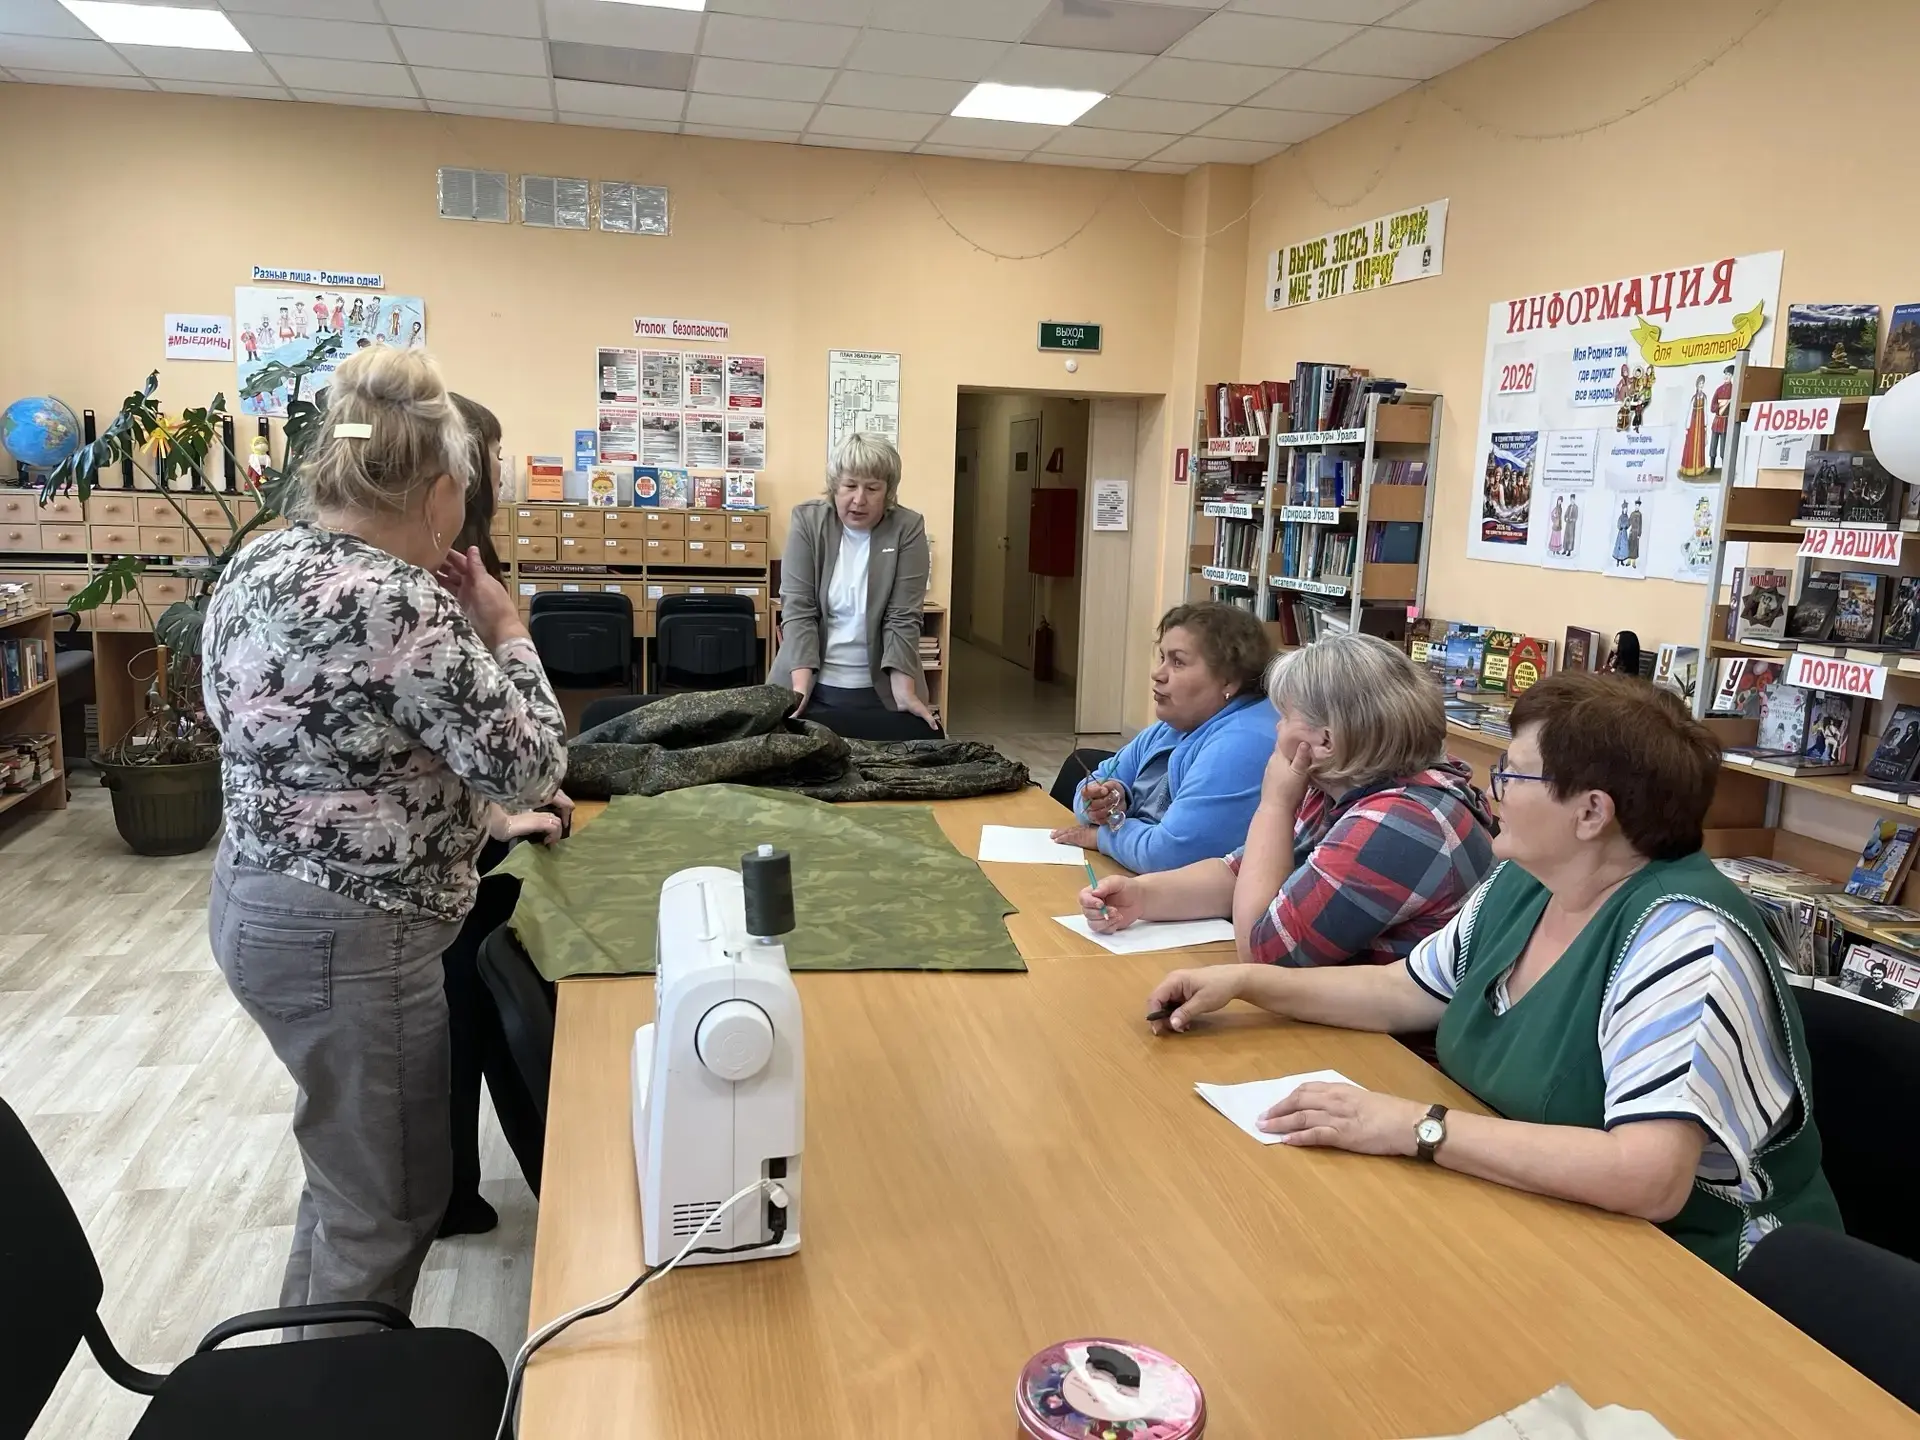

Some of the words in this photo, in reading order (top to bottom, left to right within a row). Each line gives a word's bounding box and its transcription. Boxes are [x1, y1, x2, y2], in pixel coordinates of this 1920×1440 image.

[1277, 248, 1283, 282] Я
[1288, 238, 1328, 276] ВЫРОС
[1332, 226, 1369, 265] ЗДЕСЬ
[1373, 221, 1384, 253] И
[1388, 206, 1429, 250] КРАЙ
[254, 266, 287, 280] Разные
[290, 270, 311, 283] лица
[320, 271, 354, 285] Родина
[356, 275, 382, 287] одна!
[1288, 273, 1312, 305] МНЕ
[1317, 264, 1348, 299] ЭТОТ
[1353, 251, 1399, 291] ДОРОГ
[1506, 258, 1735, 334] ИНФОРМАЦИЯ
[176, 322, 198, 333] Наш
[201, 324, 221, 334] код:
[634, 319, 666, 334] Уголок
[672, 320, 729, 338] безопасности
[1055, 326, 1084, 339] ВЫХОД
[168, 335, 231, 350] #МЫЕДИНЫ
[1061, 338, 1079, 346] EXIT
[1653, 344, 1672, 362] для
[1681, 331, 1745, 358] читателей
[1573, 347, 1587, 361] Моя
[1587, 346, 1613, 361] Родина
[1614, 346, 1628, 357] там,
[1500, 363, 1534, 391] 2026
[1578, 369, 1590, 383] где
[1590, 368, 1615, 383] дружат
[1788, 378, 1825, 387] КОГДА
[1828, 379, 1838, 387] И
[1840, 379, 1869, 388] КУДА
[1574, 390, 1588, 401] все
[1793, 386, 1810, 395] ПО
[1813, 387, 1863, 396] РОССИИ
[1754, 403, 1829, 431] Новые
[1306, 431, 1334, 443] культуры
[1337, 430, 1357, 443] Урала
[1204, 504, 1227, 517] История
[1229, 504, 1248, 517] Урала
[1282, 507, 1312, 521] Природа
[1313, 508, 1335, 523] Урала
[1801, 528, 1829, 554] на
[1830, 530, 1898, 560] наших
[1203, 567, 1225, 580] Города
[1226, 569, 1247, 584] Урала
[1271, 575, 1296, 588] Писатели
[1303, 583, 1322, 593] поэты
[1324, 585, 1345, 596] Урала
[1799, 658, 1875, 694] полках
